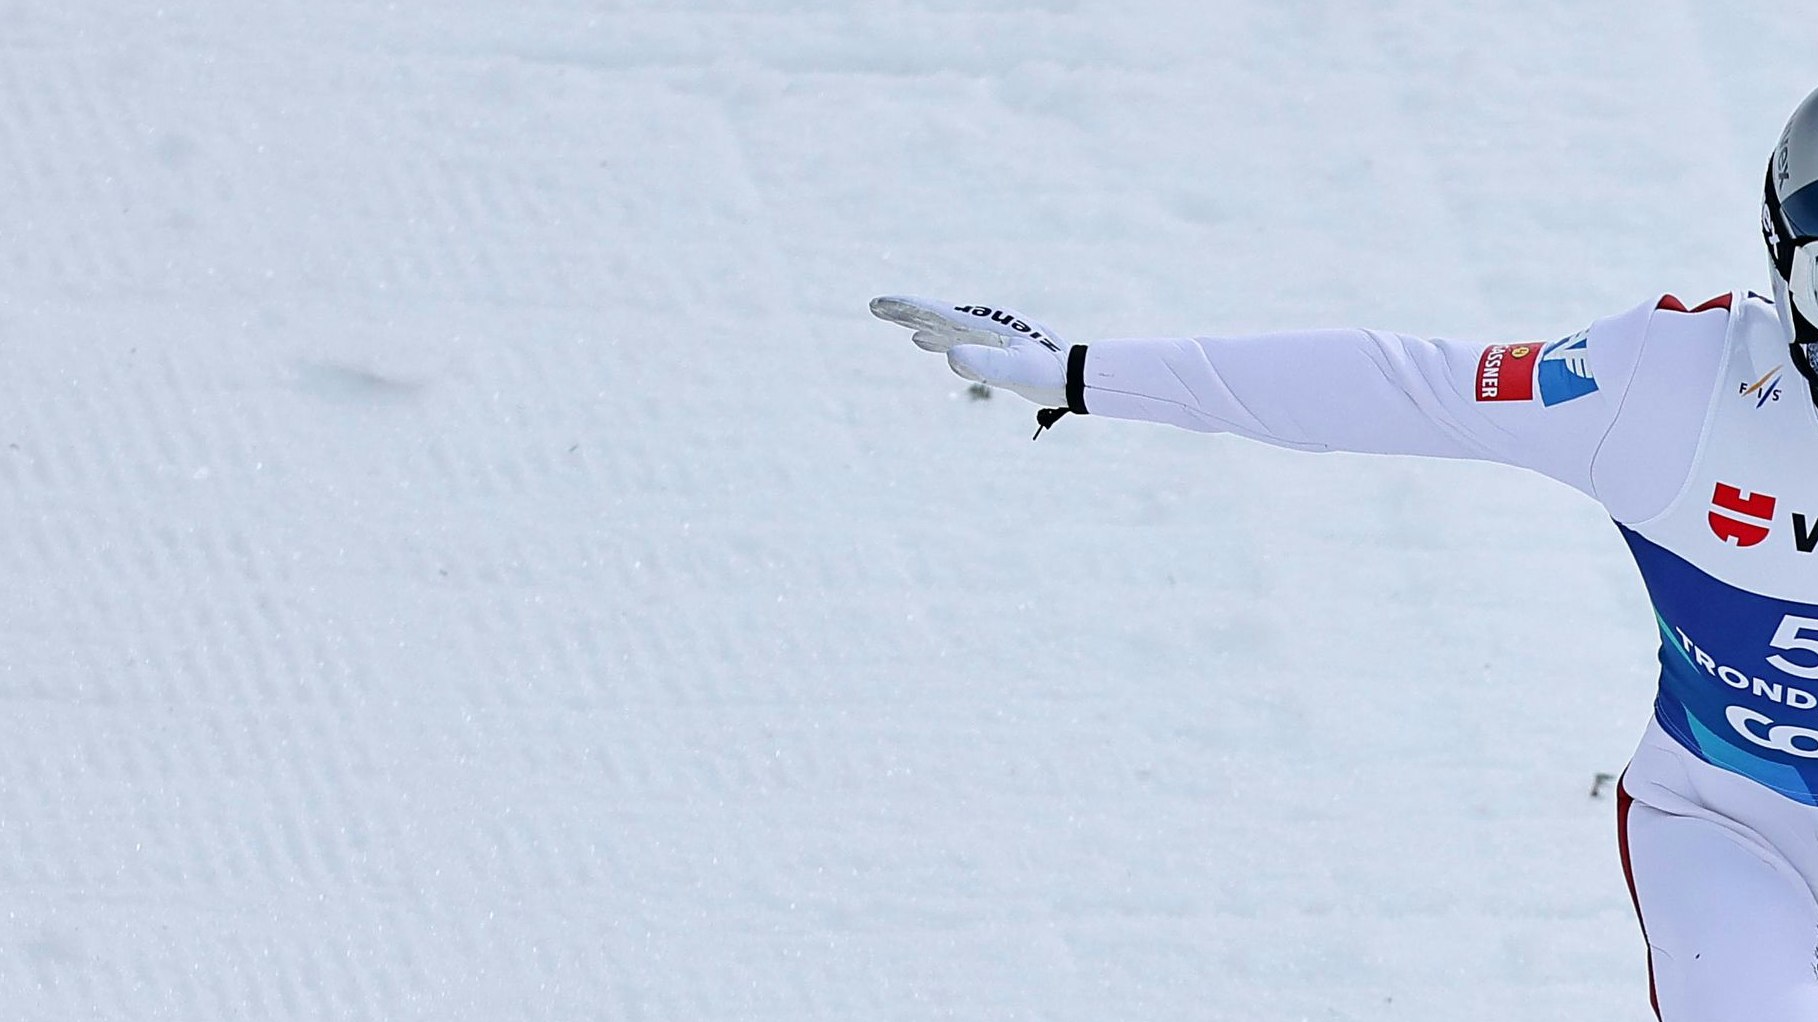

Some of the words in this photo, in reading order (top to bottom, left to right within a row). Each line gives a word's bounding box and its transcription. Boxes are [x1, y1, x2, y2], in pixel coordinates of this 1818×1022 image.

[954, 305, 1061, 352] ziener
[1481, 346, 1508, 398] ASSNER
[1739, 382, 1782, 401] FIS
